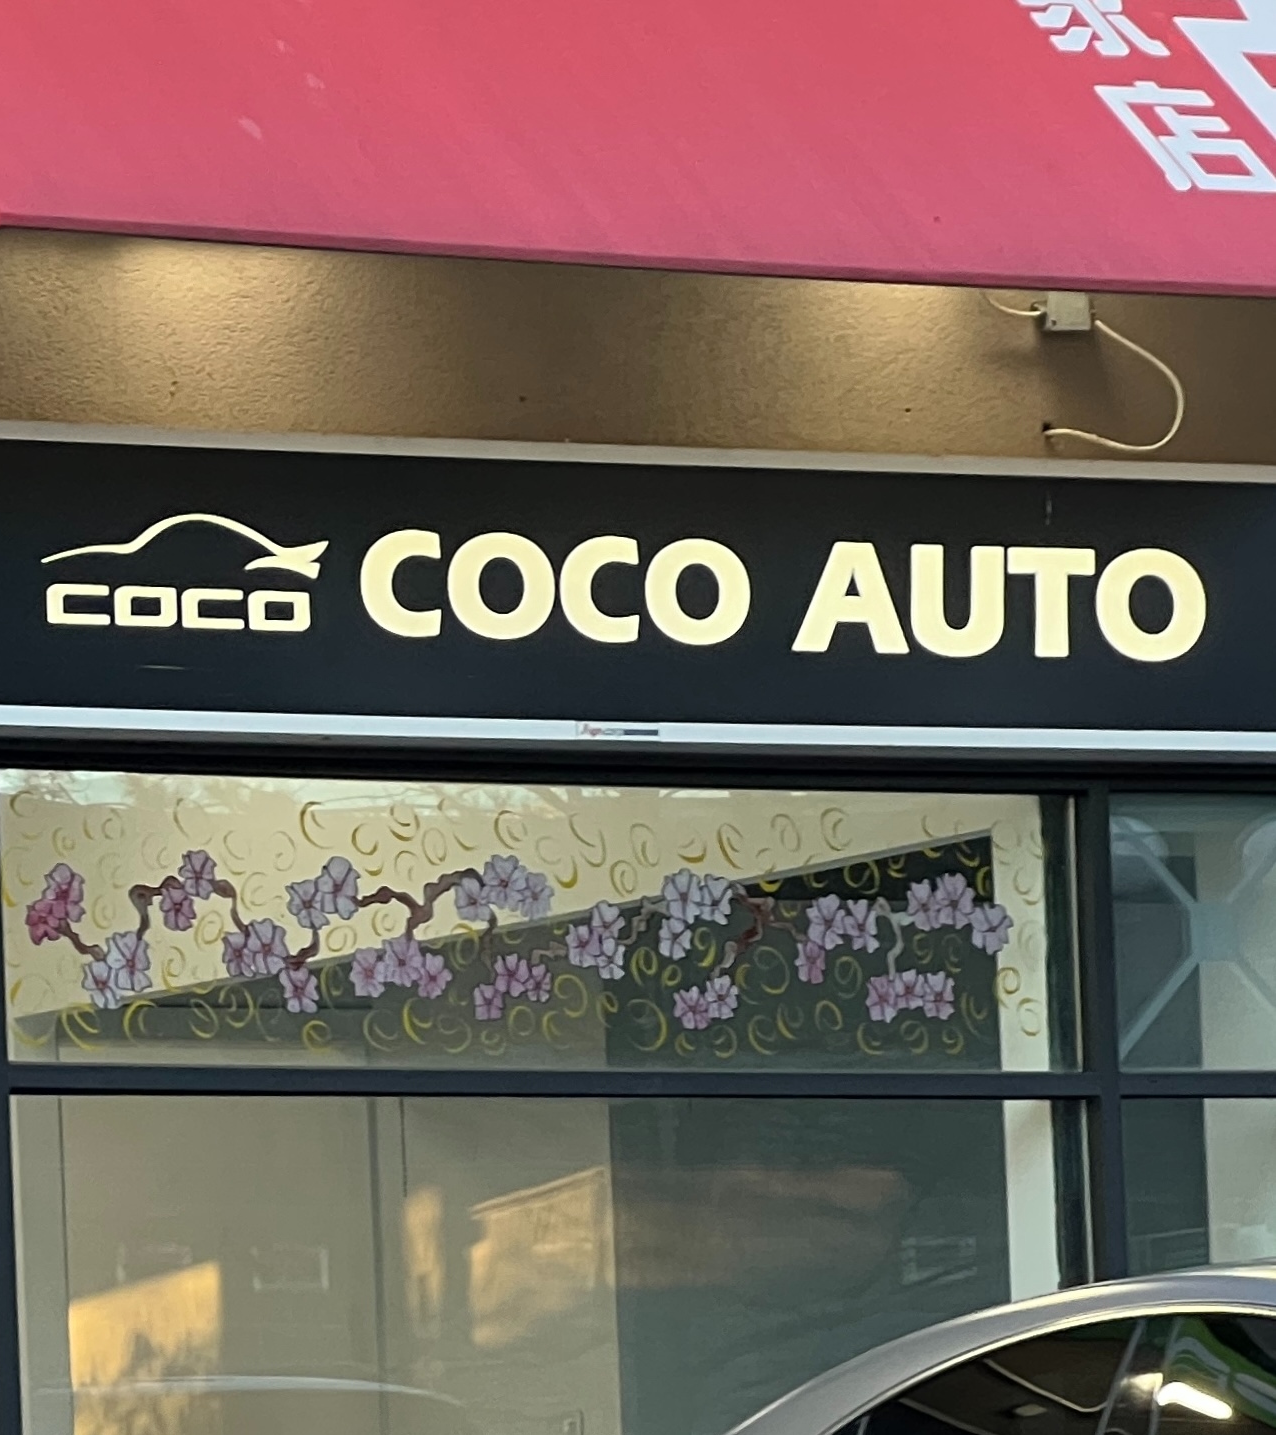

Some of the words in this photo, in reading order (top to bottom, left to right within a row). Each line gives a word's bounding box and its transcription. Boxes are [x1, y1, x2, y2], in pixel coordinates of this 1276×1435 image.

[45, 583, 311, 632] COCO
[359, 529, 751, 646] COCO
[791, 541, 1207, 663] AUTO
